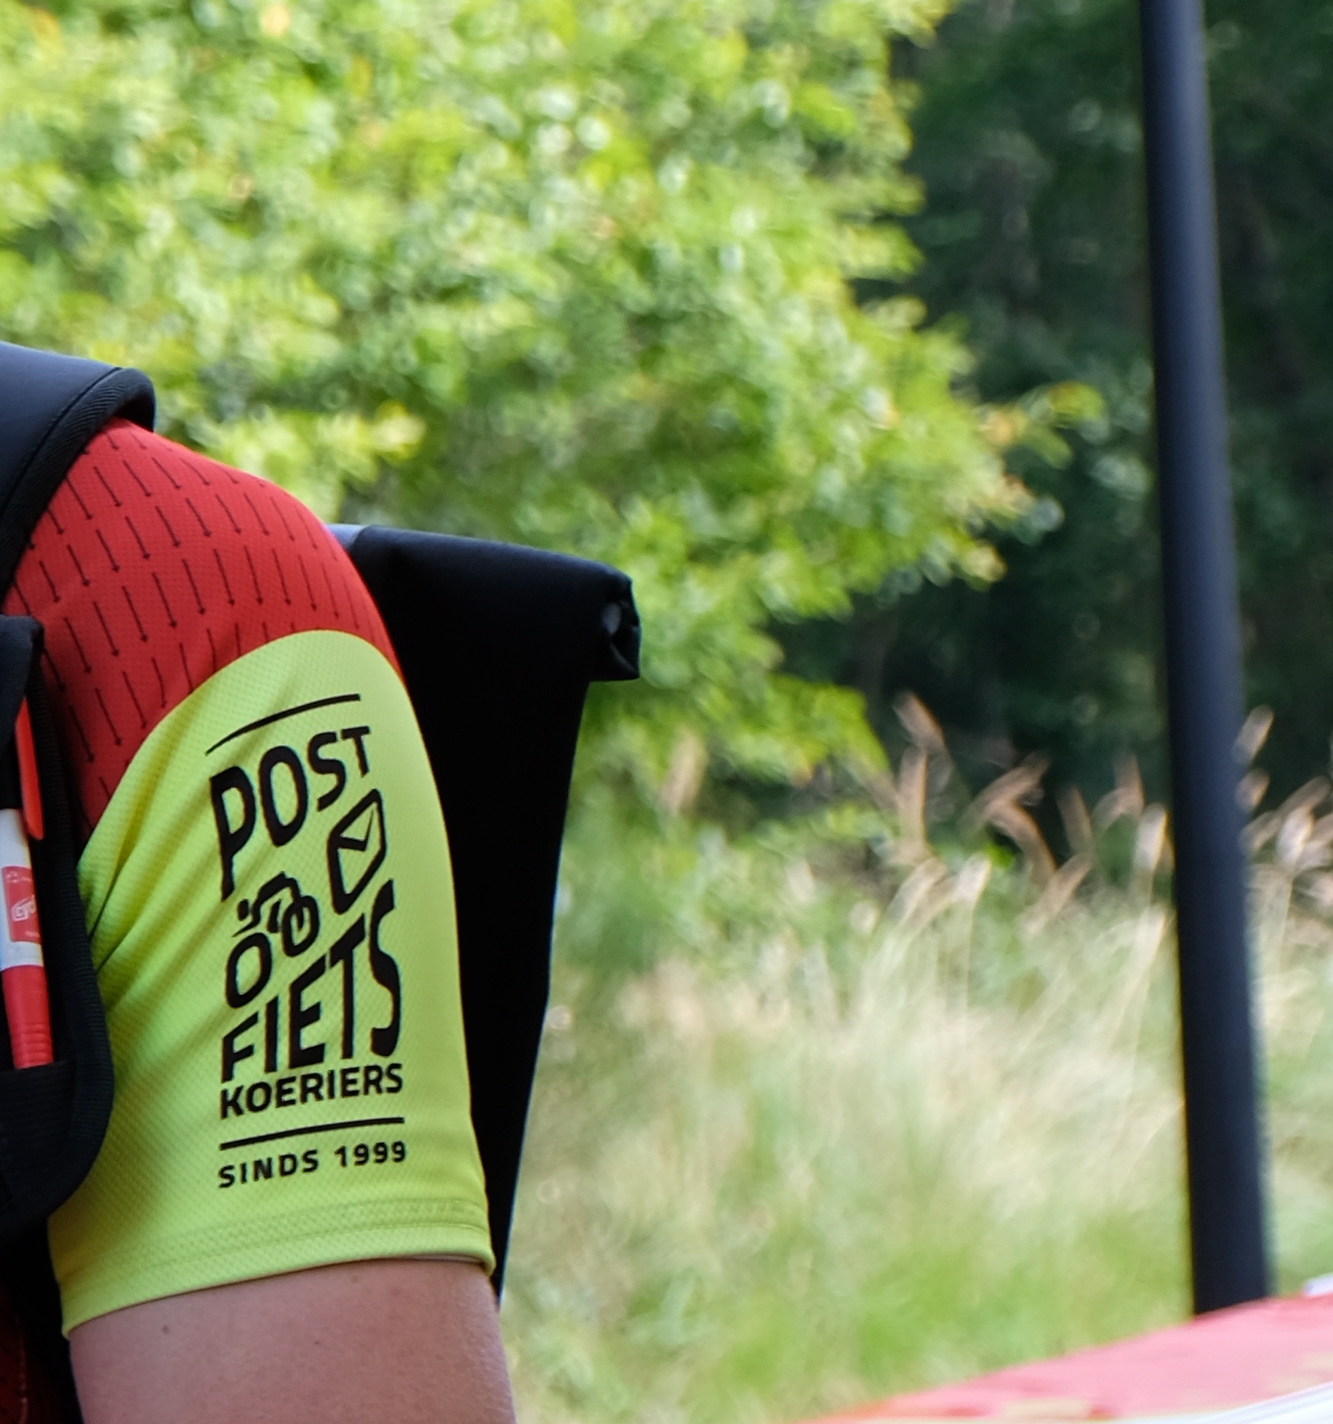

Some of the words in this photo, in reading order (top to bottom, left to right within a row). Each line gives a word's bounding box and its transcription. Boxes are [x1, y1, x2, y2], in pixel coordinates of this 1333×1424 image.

[209, 725, 372, 903] POST
[221, 879, 402, 1083] FIETS
[219, 1062, 403, 1120] KOERIERS
[218, 1149, 320, 1189] SINDS
[334, 1140, 407, 1169] 1999
